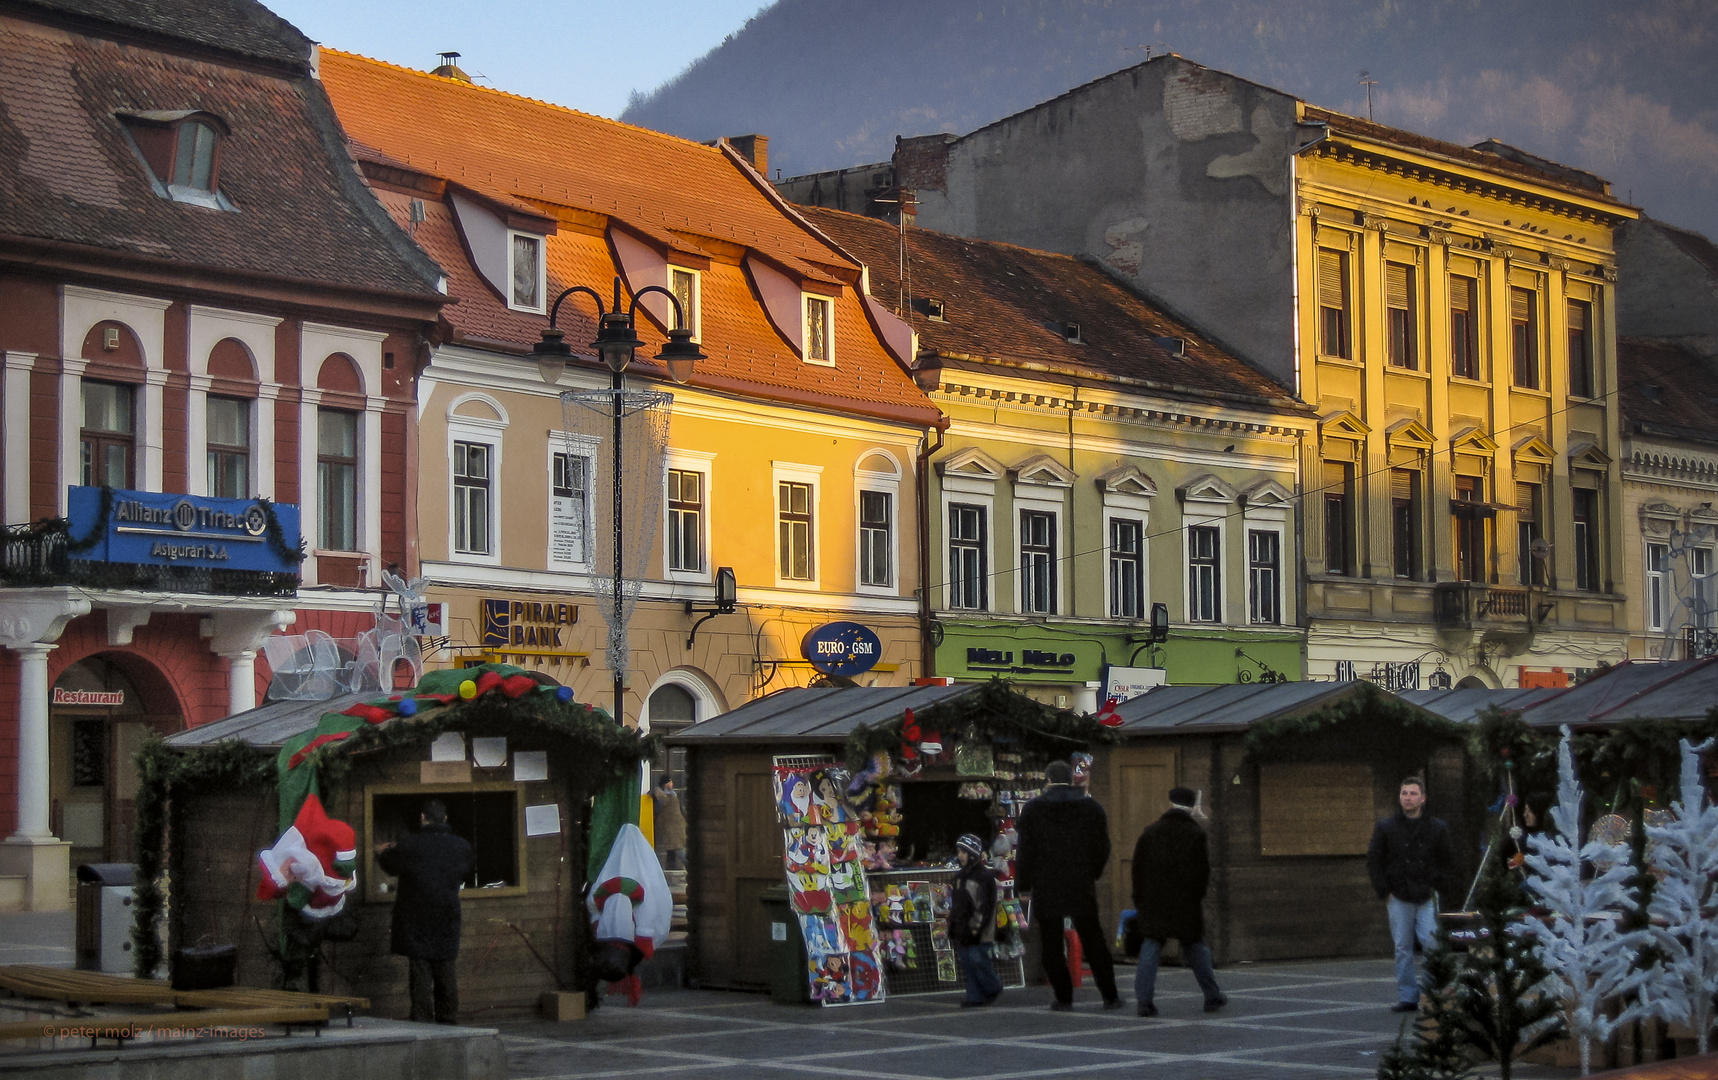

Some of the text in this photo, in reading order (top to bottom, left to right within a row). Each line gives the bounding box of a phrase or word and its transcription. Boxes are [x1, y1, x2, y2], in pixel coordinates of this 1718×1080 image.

[117, 500, 172, 524] Allianz
[428, 610, 440, 619] KFC
[511, 602, 580, 625] PIRAEU
[511, 625, 562, 647] BANK
[818, 641, 844, 654] EURO
[852, 643, 873, 654] GSM
[53, 688, 124, 705] Restaurant
